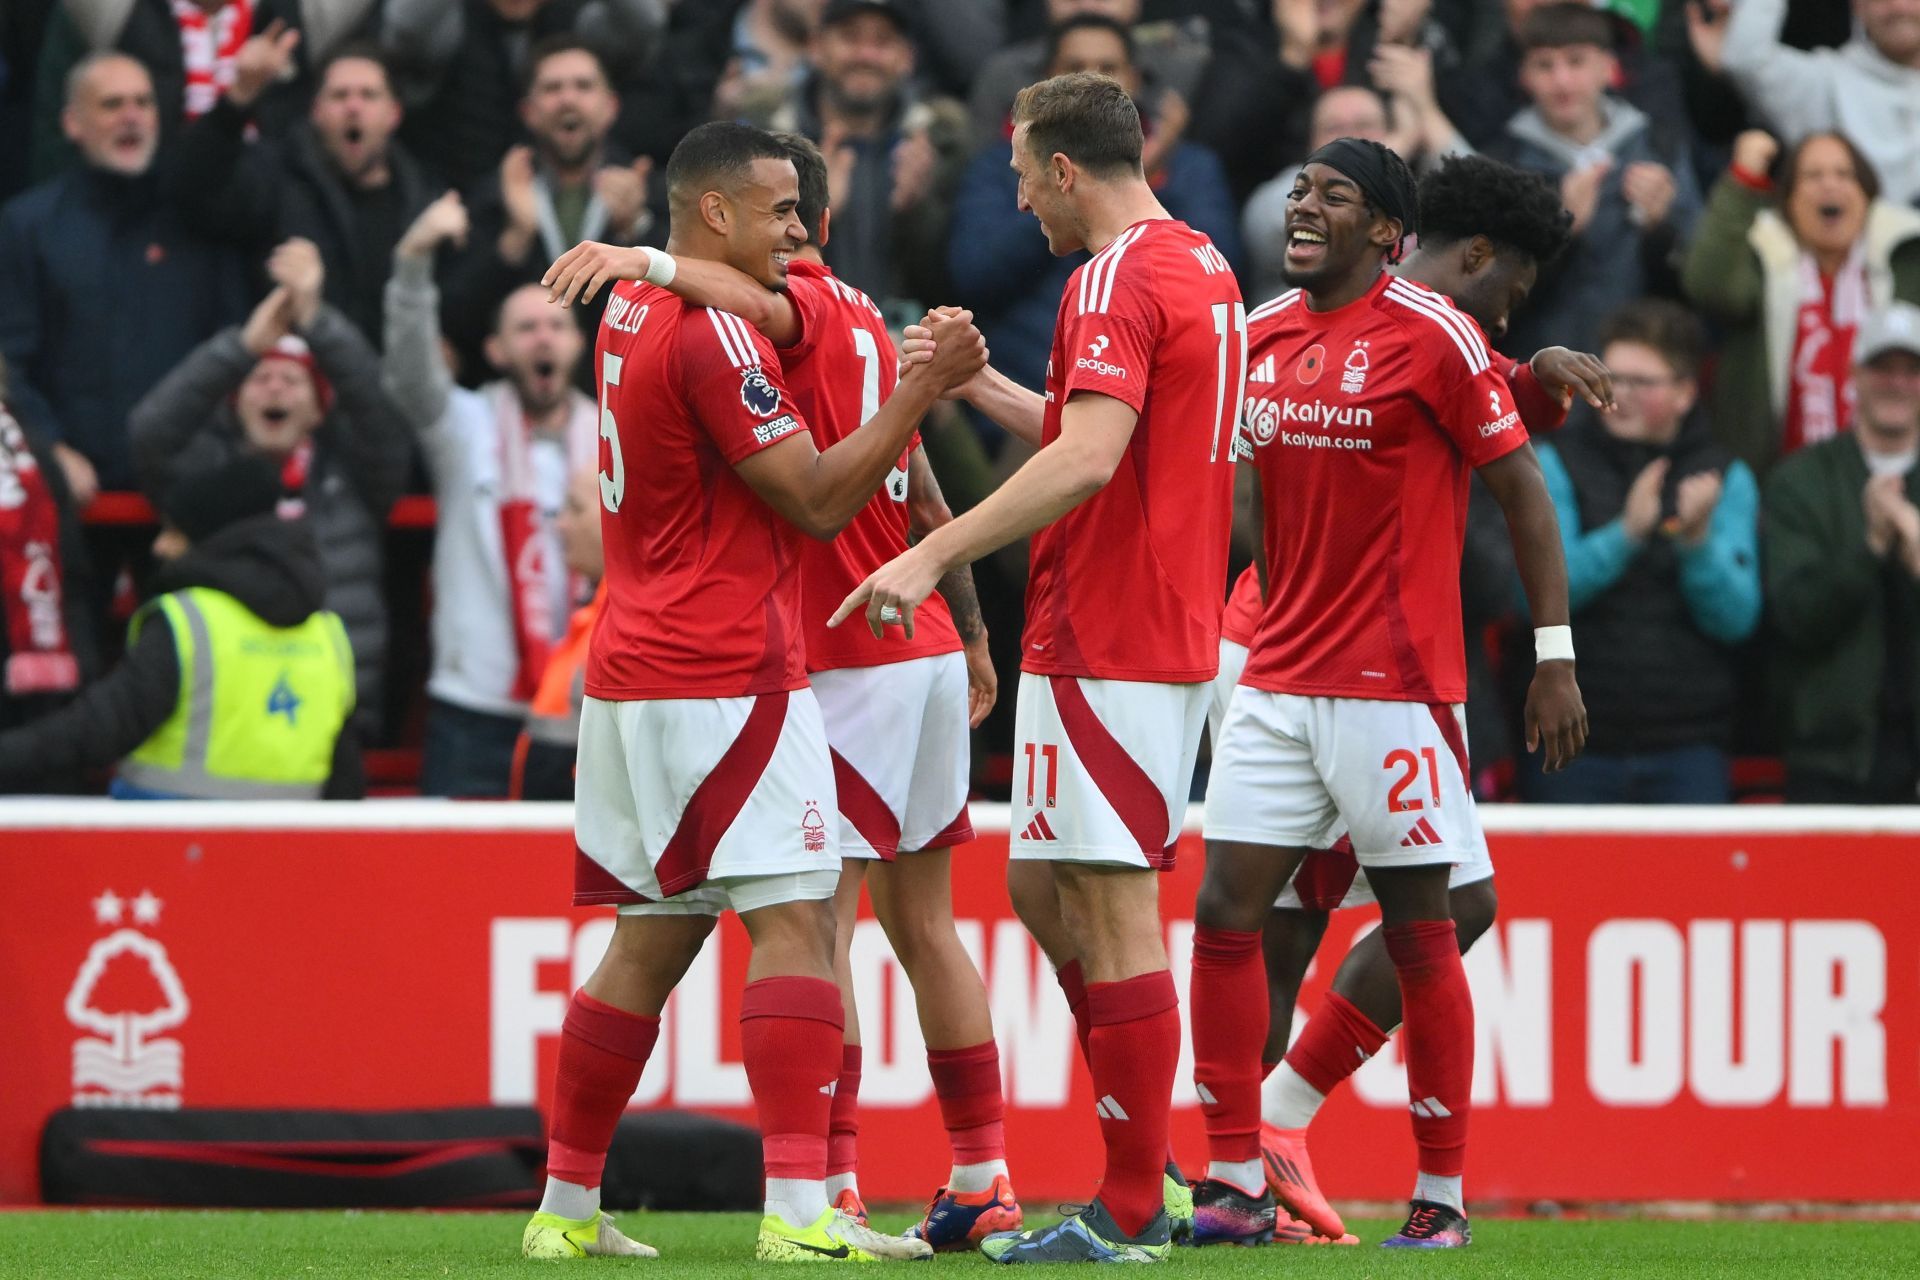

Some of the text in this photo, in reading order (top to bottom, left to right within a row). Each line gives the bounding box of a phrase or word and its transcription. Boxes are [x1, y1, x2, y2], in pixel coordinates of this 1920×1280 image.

[1210, 302, 1249, 463] 11
[599, 350, 625, 514] 5
[752, 415, 793, 437] No room
[757, 421, 800, 445] for racism
[1282, 430, 1373, 450] kaiyun.com
[1024, 742, 1058, 808] 11
[1383, 746, 1441, 813] 21
[1586, 917, 1888, 1108] OUR
